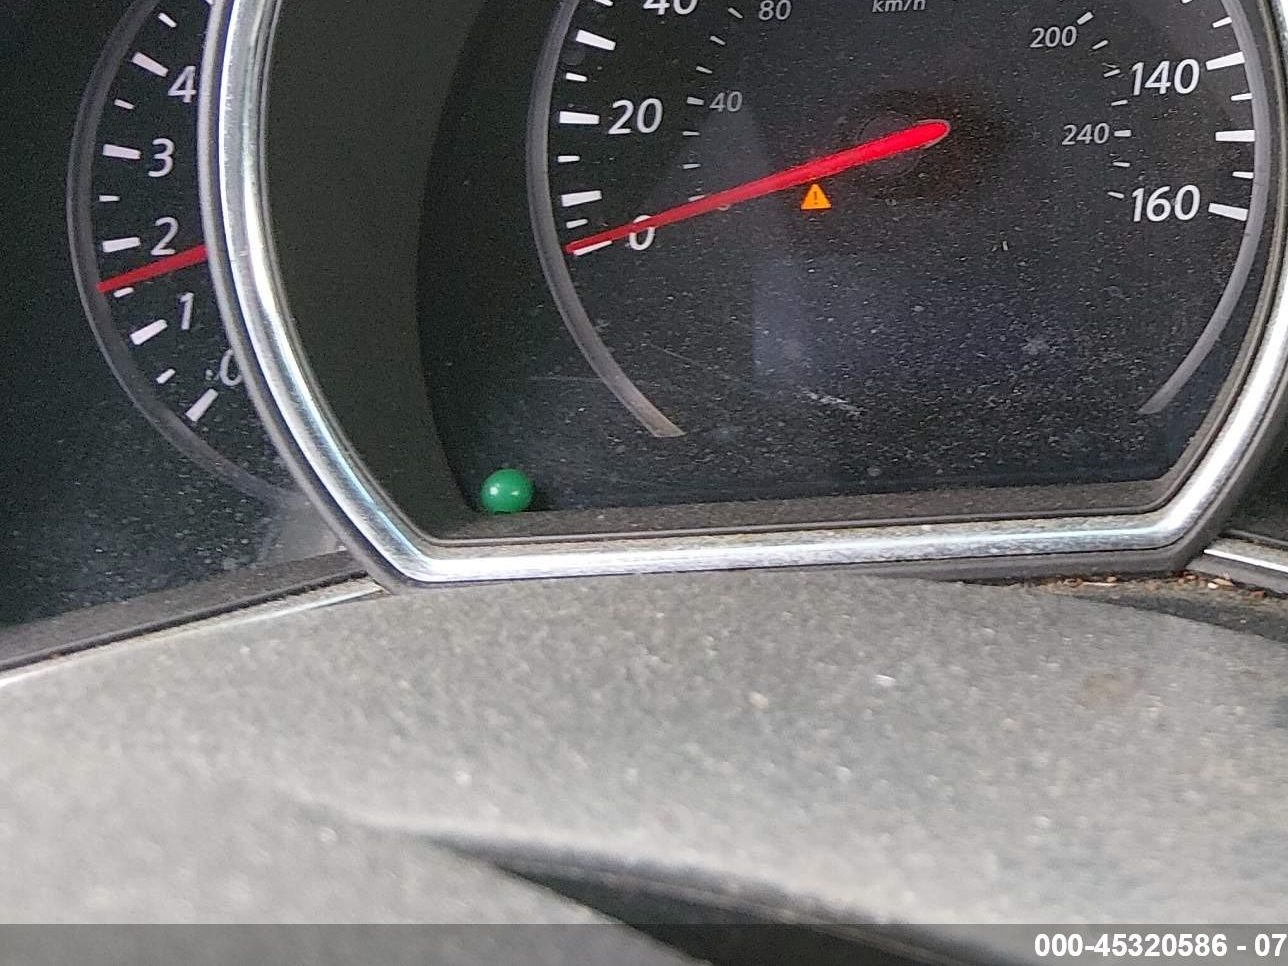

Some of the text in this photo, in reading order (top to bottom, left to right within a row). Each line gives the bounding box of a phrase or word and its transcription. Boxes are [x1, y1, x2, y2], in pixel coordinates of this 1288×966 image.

[758, 0, 792, 21] 80
[1029, 25, 1077, 48] 200
[167, 65, 197, 103] 4
[1131, 58, 1200, 96] 140
[607, 97, 664, 135] 20
[709, 91, 743, 113] 40
[1061, 122, 1110, 145] 240
[147, 137, 175, 178] 3
[1132, 184, 1201, 222] 160
[150, 216, 177, 256] 2
[629, 214, 656, 251] 0
[179, 292, 194, 331] 1
